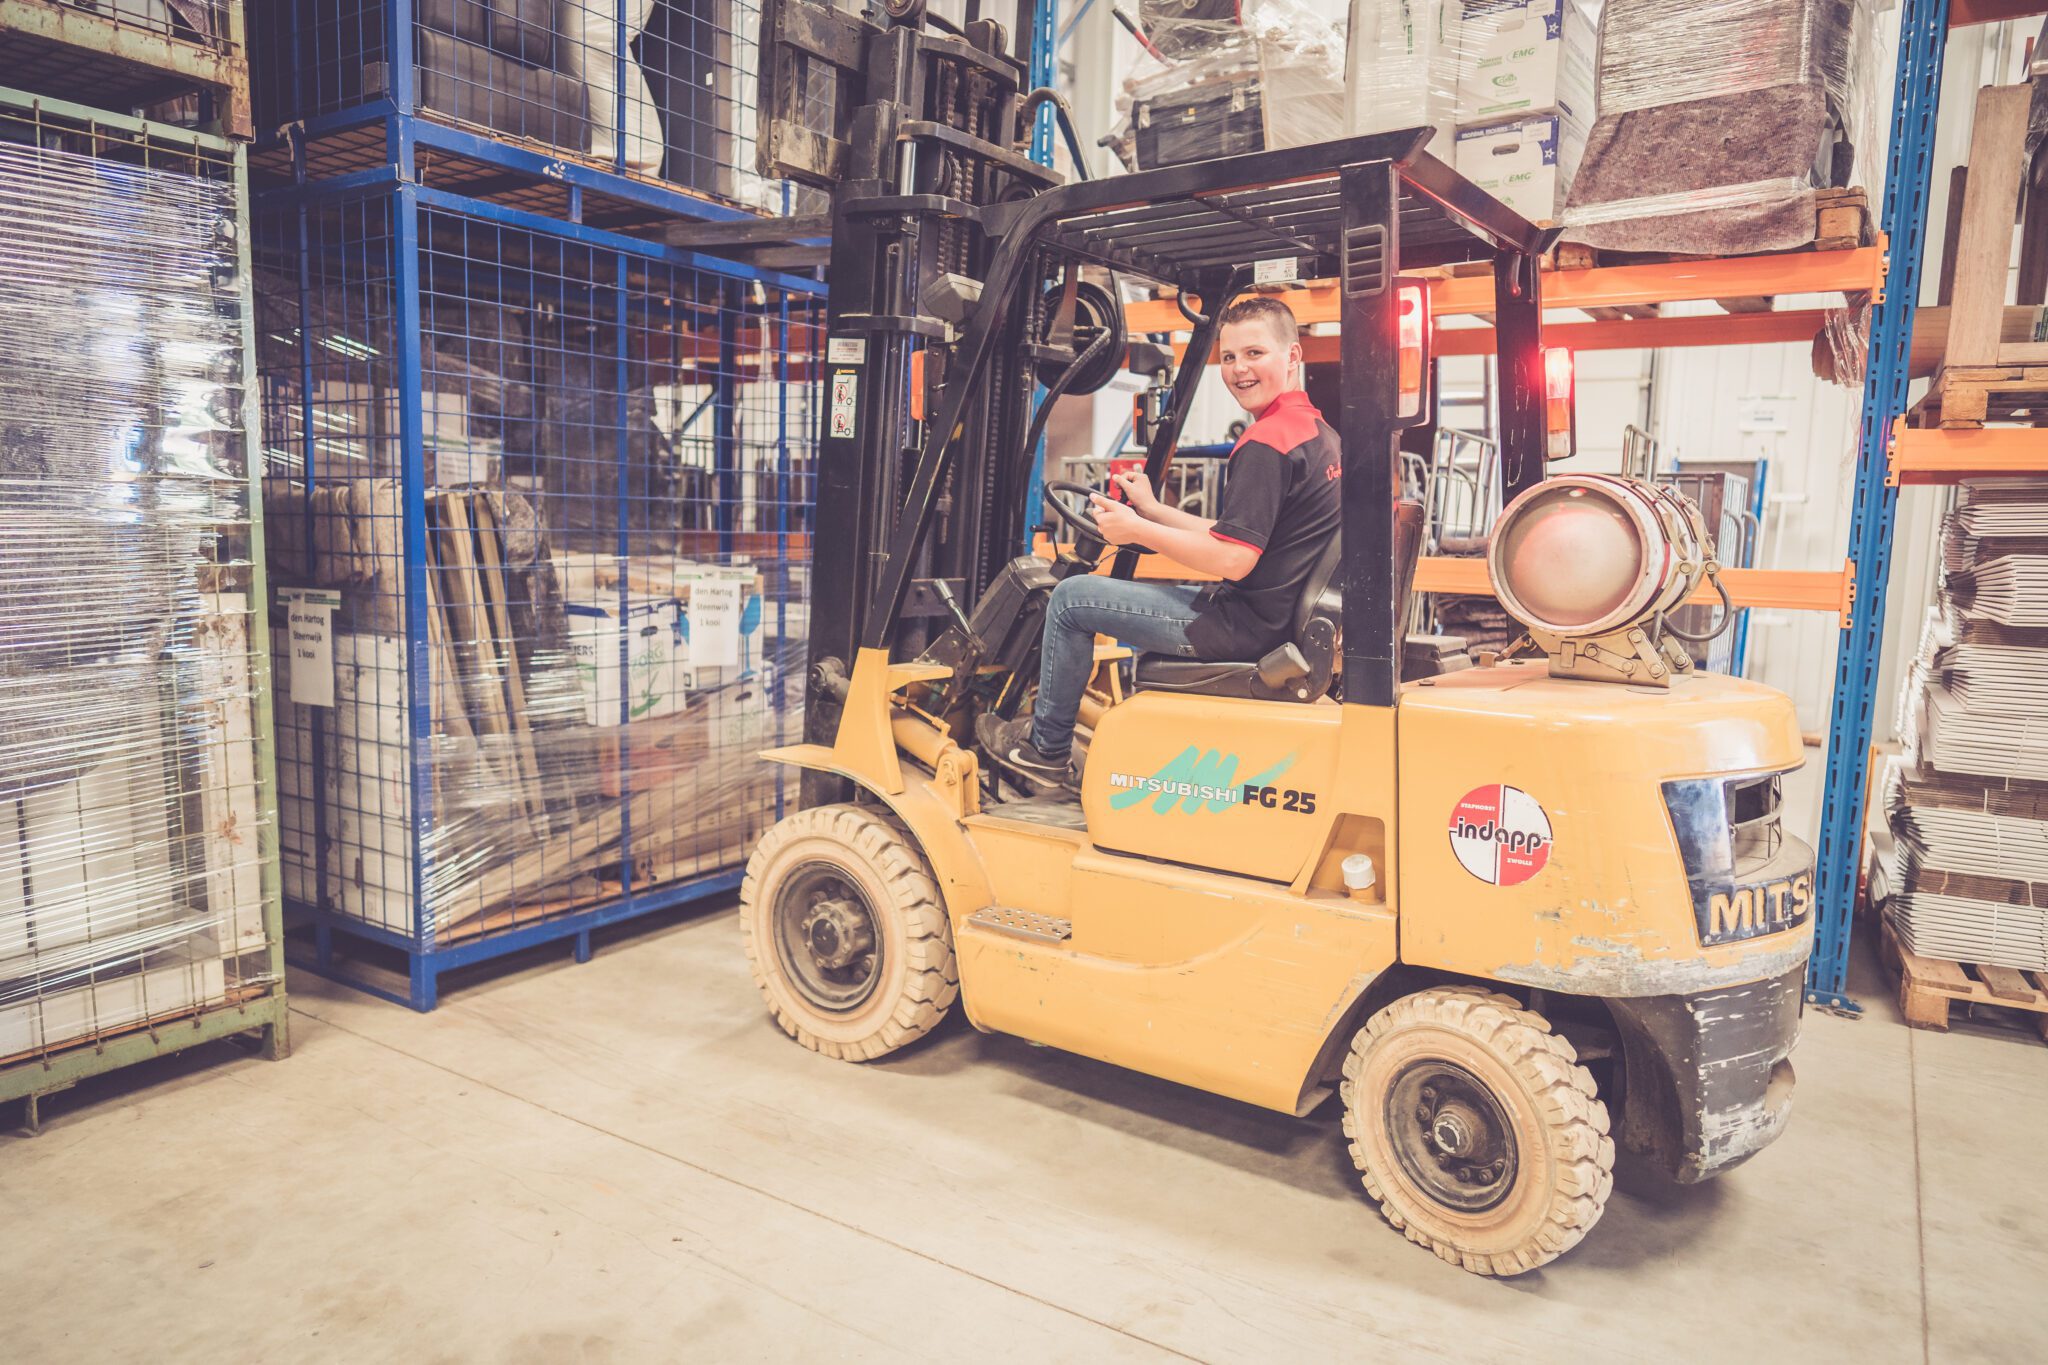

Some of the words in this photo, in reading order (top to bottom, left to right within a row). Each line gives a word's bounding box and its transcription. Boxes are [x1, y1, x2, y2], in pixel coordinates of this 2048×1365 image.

[1512, 47, 1536, 59] EMG
[1509, 171, 1532, 183] EMG
[695, 587, 709, 597] den
[710, 587, 733, 598] Hartog
[696, 602, 729, 613] Steenwijk
[291, 614, 303, 623] den
[304, 614, 324, 626] Hartog
[293, 631, 322, 643] Steenwijk
[302, 648, 316, 659] kooi
[1109, 772, 1238, 804] MITSUBISHI
[1242, 784, 1278, 810] FG
[1282, 789, 1317, 816] 25
[1457, 816, 1542, 855] indapp
[1709, 871, 1813, 936] MITS
